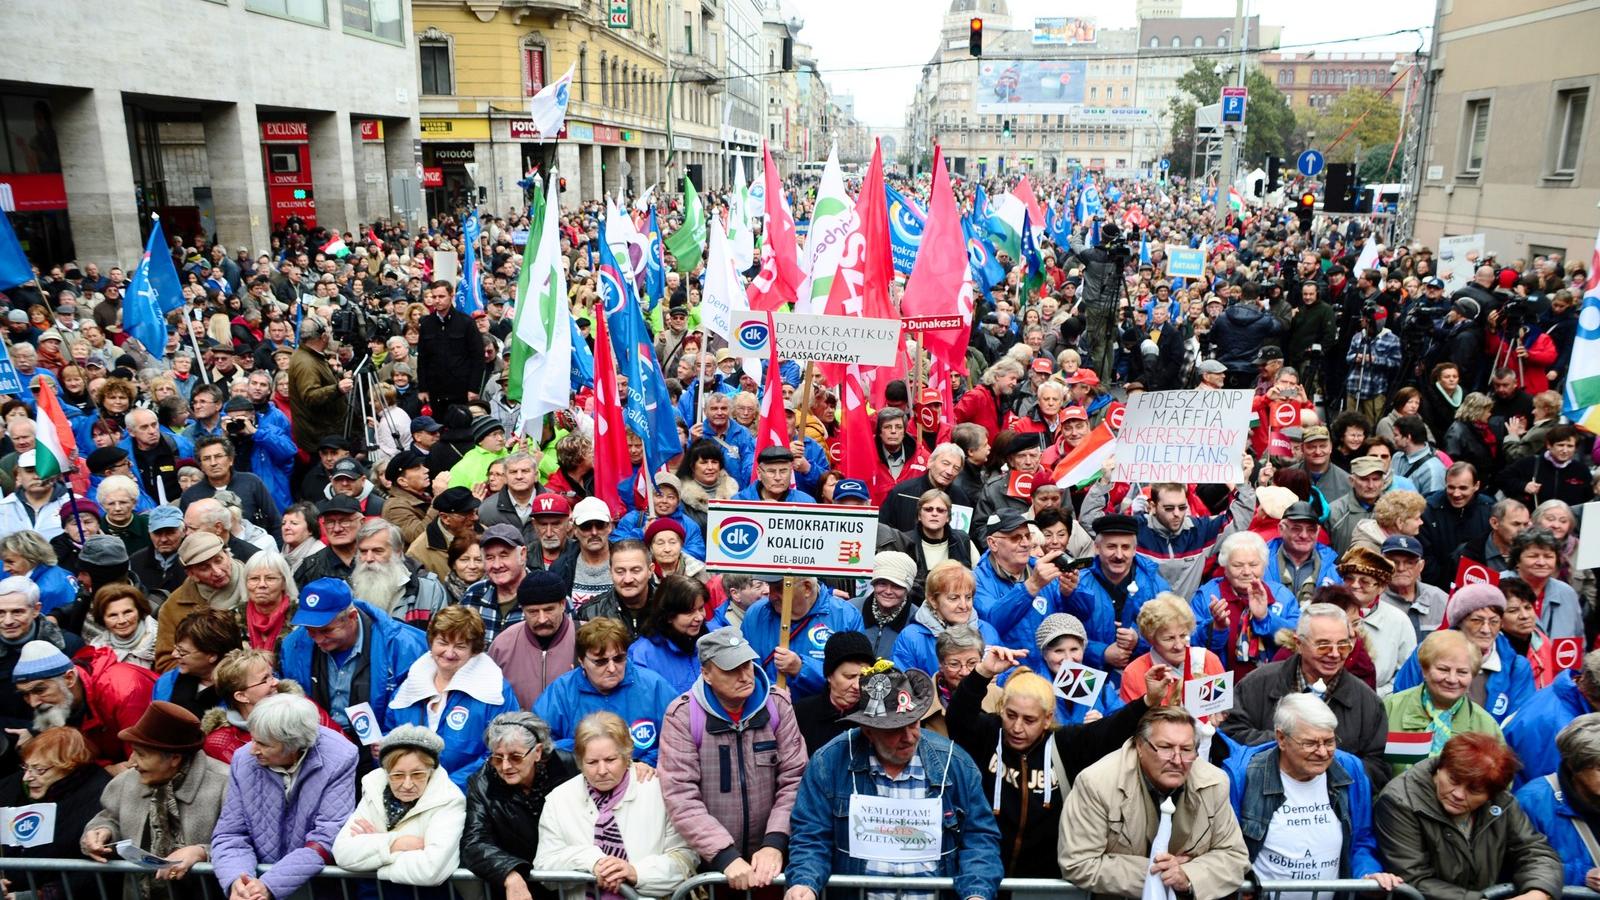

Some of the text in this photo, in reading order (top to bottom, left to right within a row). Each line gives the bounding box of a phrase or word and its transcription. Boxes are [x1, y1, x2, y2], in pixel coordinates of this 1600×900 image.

[267, 122, 308, 135] EXCLUSIVE
[275, 175, 298, 183] CHANGE
[908, 317, 961, 330] Dunakeszi
[745, 328, 761, 340] dk
[776, 322, 895, 341] DEMOKRATIKUS
[775, 337, 848, 352] KOALÍCIÓ
[1138, 390, 1243, 409] FIDESZ KDNP
[1151, 409, 1223, 428] MAFFIA
[540, 498, 554, 510] W
[768, 518, 864, 534] DEMOKRATIKUS
[727, 528, 749, 545] dk
[767, 535, 825, 550] KOALÍCIÓ
[355, 718, 369, 731] dk
[636, 727, 651, 739] dk
[861, 806, 931, 818] NEM LOPTAM!
[18, 819, 35, 832] dk
[1286, 818, 1312, 827] nem
[1304, 848, 1312, 858] A
[1268, 854, 1317, 870] többinek
[1290, 870, 1321, 881] Tilos!
